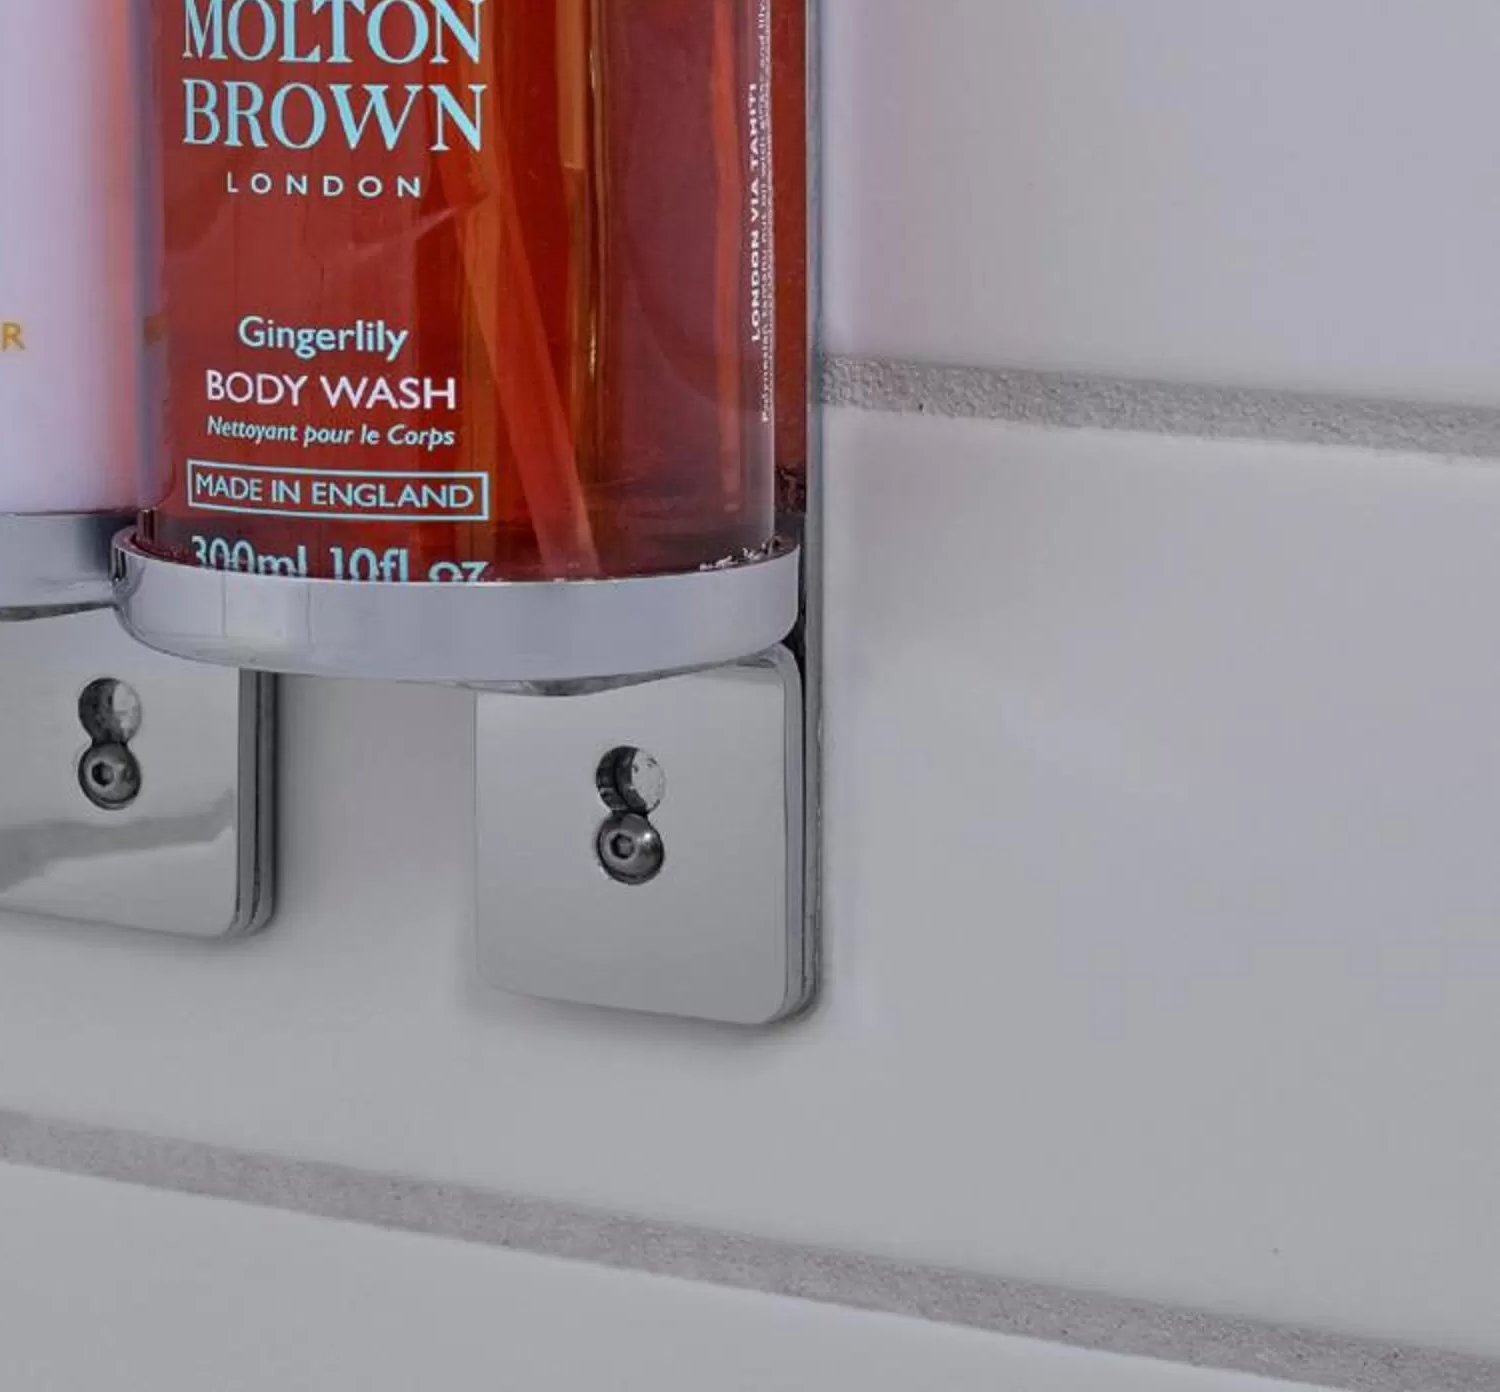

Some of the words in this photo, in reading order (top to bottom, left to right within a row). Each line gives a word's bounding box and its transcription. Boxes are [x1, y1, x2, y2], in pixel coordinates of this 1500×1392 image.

[182, 78, 488, 152] BROWN
[748, 82, 760, 173] TAHITI
[227, 171, 421, 198] LONDON
[750, 177, 760, 222] VIA
[750, 230, 761, 342] LONDON
[239, 315, 409, 363] Gingerlily
[206, 369, 308, 407] BODY
[320, 375, 456, 410] WASH
[207, 414, 297, 445] Nettoyant
[303, 425, 354, 449] pour
[360, 423, 380, 446] le
[388, 424, 455, 451] Corps
[196, 471, 262, 502] MADE
[271, 478, 300, 504] IN
[312, 482, 474, 508] ENGLAND
[191, 535, 308, 577] 300ml
